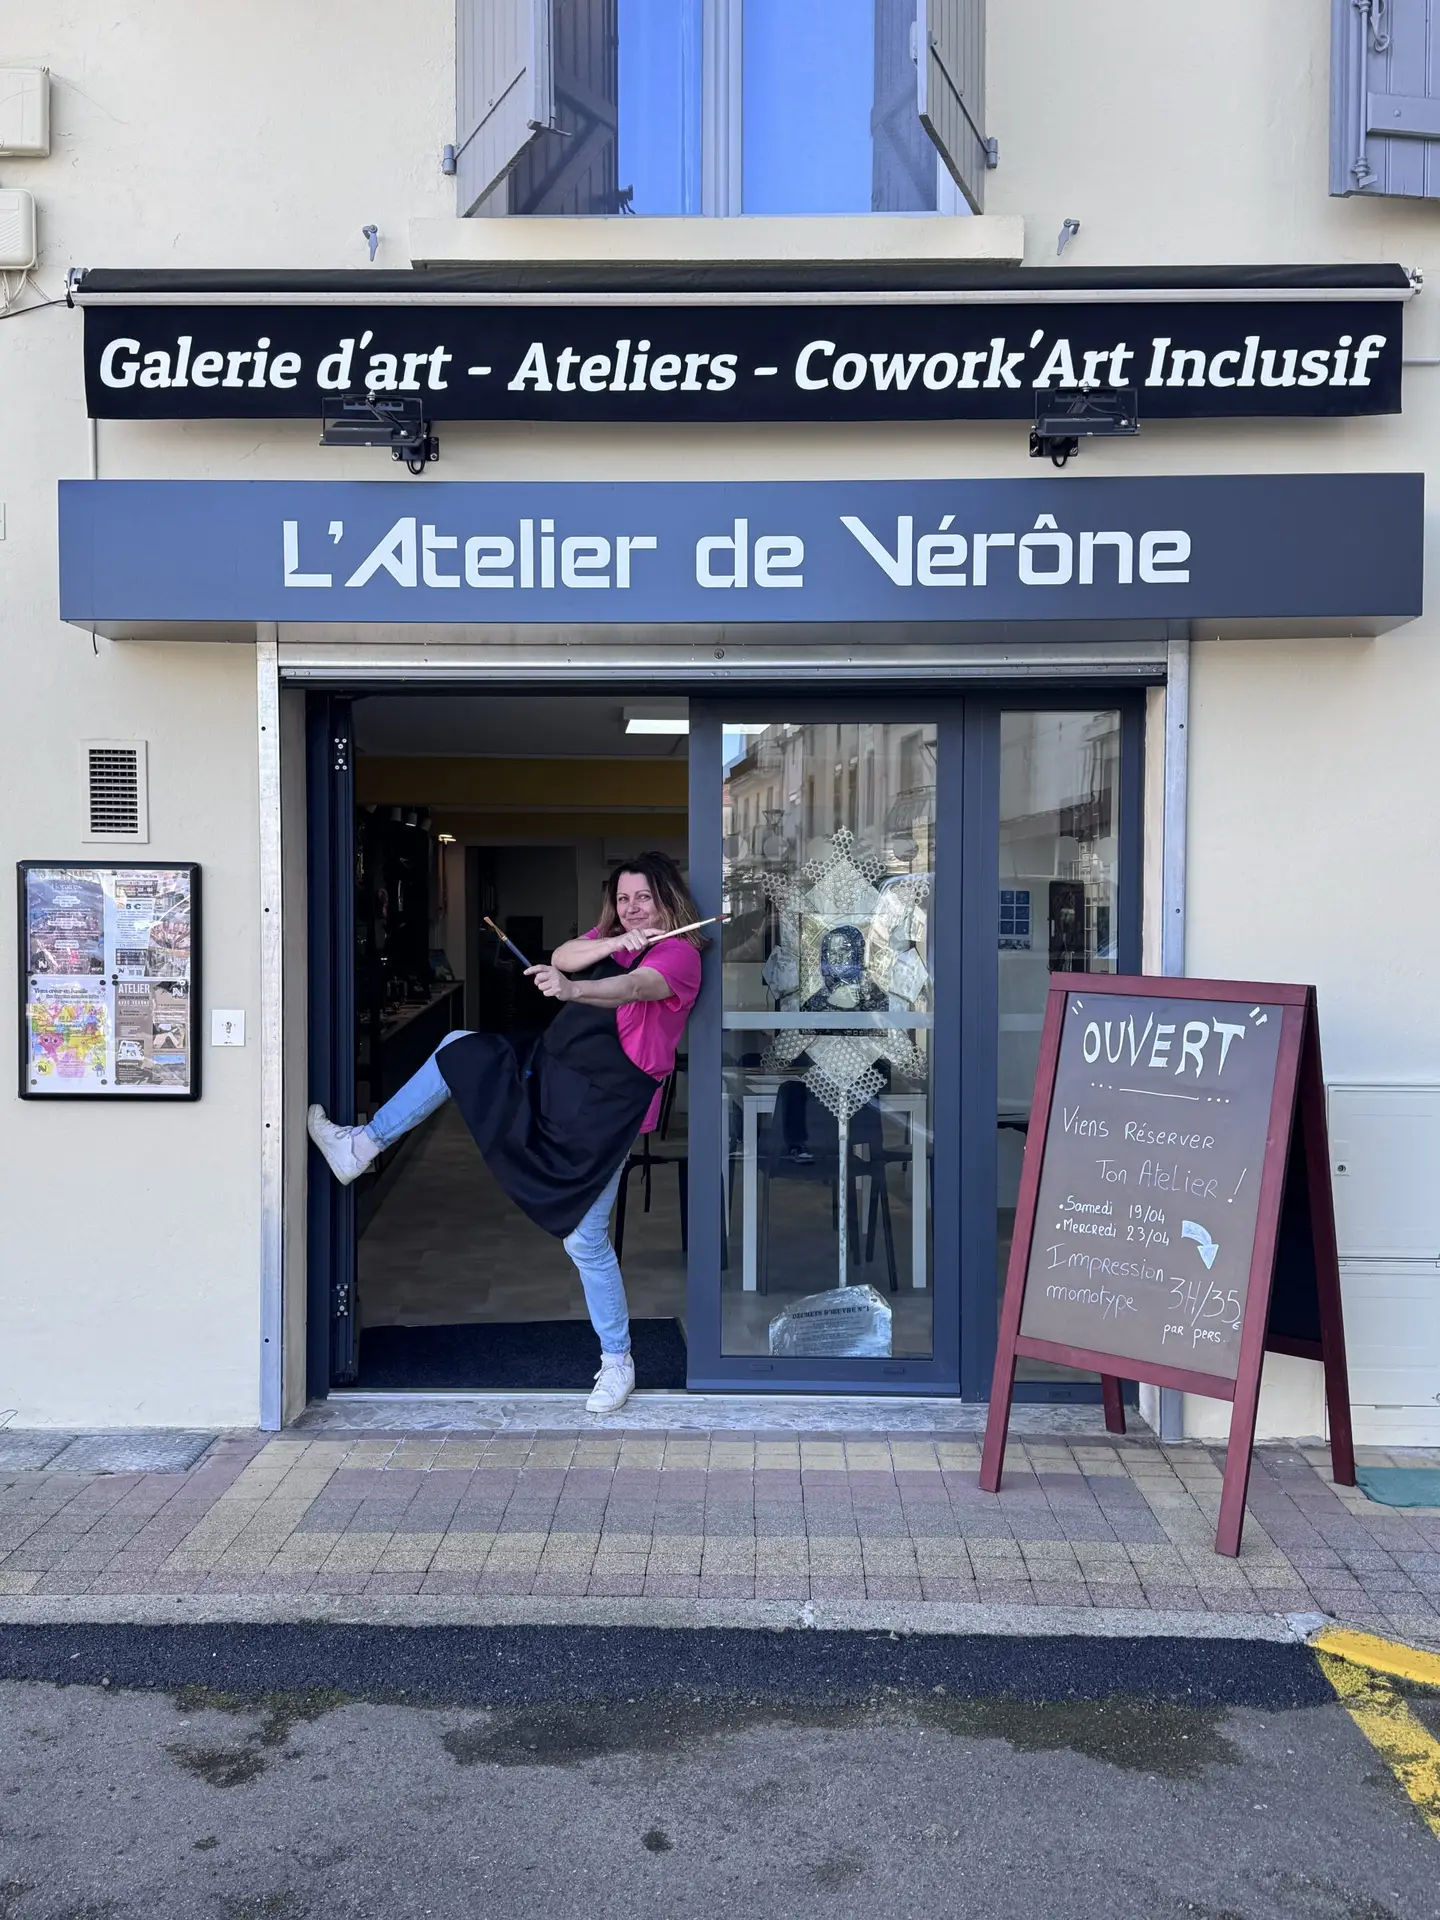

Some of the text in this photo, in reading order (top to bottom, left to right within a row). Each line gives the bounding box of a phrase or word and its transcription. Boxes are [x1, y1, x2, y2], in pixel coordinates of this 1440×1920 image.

[100, 336, 302, 388] Galerie
[317, 331, 452, 390] d'art
[508, 340, 738, 392] Ateliers
[795, 330, 1134, 390] Cowork'Art
[1144, 335, 1387, 388] Inclusif
[283, 513, 1191, 588] L'Atelier de Vérône
[118, 983, 150, 994] ATELIER
[1082, 1011, 1246, 1078] OUVERT
[1063, 1106, 1109, 1139] Viens
[1096, 1159, 1128, 1184] Ton
[1129, 1204, 1165, 1224] 19/04
[1126, 1226, 1170, 1248] 23/04
[1046, 1243, 1164, 1283] Impression
[1161, 1324, 1184, 1345] par
